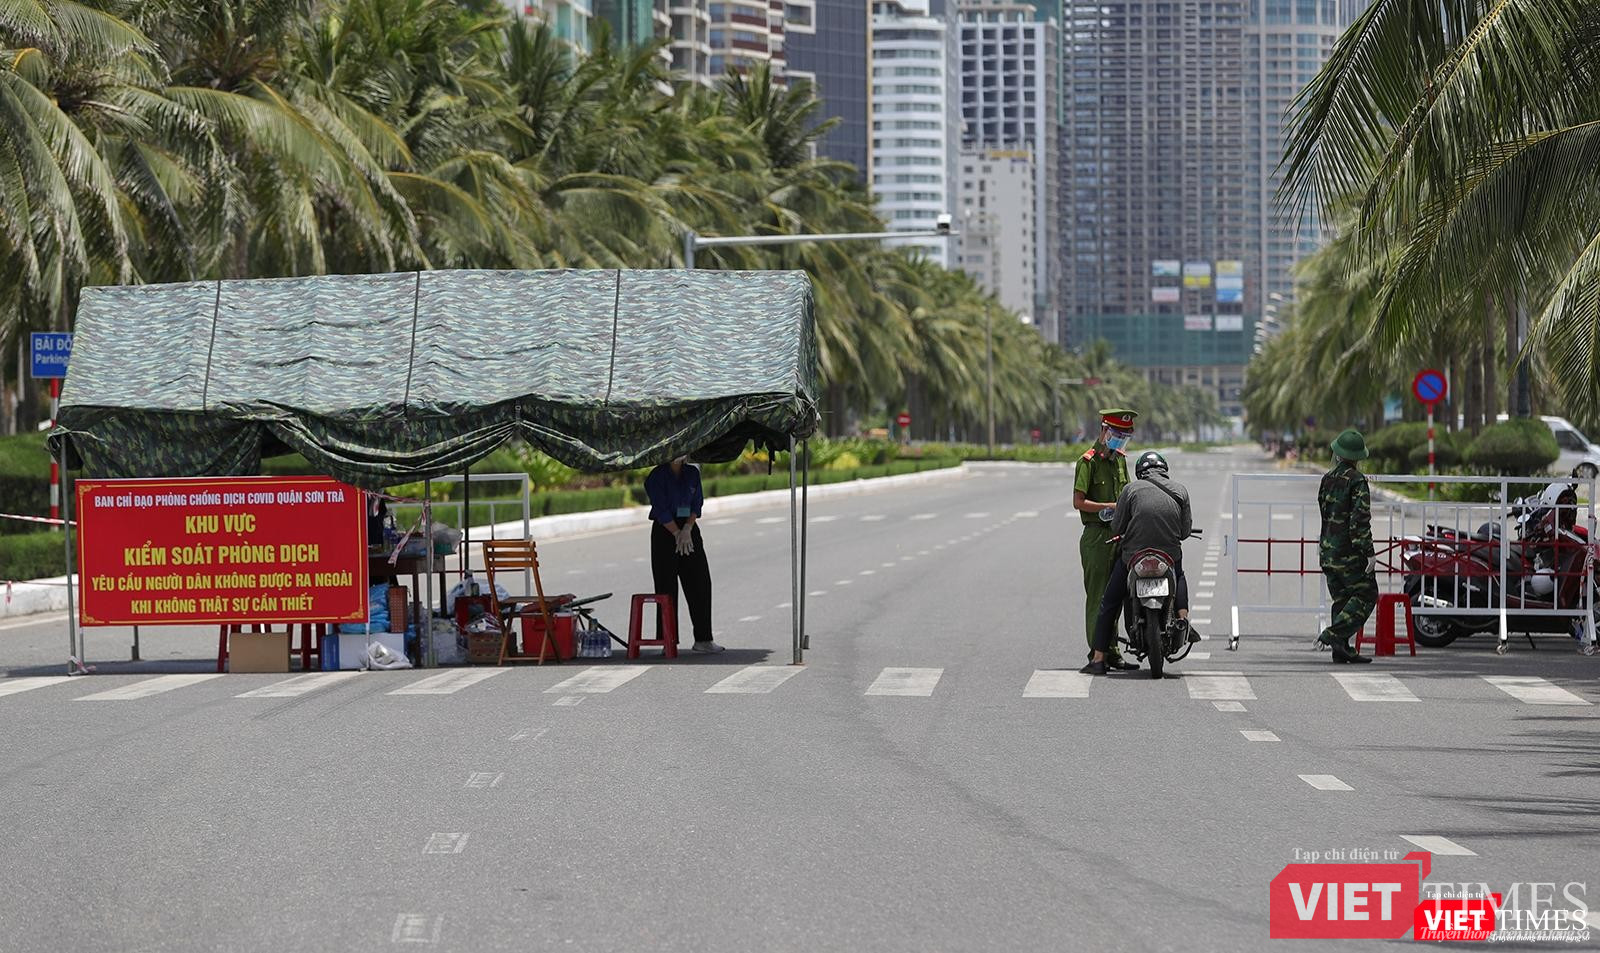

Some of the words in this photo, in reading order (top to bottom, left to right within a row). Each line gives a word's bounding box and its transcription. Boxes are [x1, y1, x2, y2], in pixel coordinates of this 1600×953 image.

[94, 496, 114, 507] BAN
[116, 492, 132, 507] CHỈ
[134, 495, 153, 509] ĐẠO
[155, 492, 187, 506] PHÒNG
[189, 489, 221, 505] CHỐNG
[223, 493, 245, 507] DỊCH
[248, 493, 275, 504] COVID
[277, 490, 302, 506] QUẬN
[305, 491, 324, 503] SƠN
[326, 489, 344, 503] TRÀ
[185, 515, 218, 534] KHU
[224, 513, 256, 537] VỰC
[124, 540, 166, 566] KIỂM
[171, 545, 213, 565] SOÁT
[218, 541, 275, 563] PHÒNG
[280, 544, 319, 565] DỊCH
[92, 574, 115, 591] YÊU
[118, 574, 142, 591] CẦU
[145, 574, 183, 590] NGƯỜI
[186, 573, 211, 589] DÂN
[214, 573, 256, 588] KHÔNG
[259, 573, 292, 590] ĐƯỢC
[295, 573, 312, 587] RA
[315, 570, 352, 587] NGOÀI
[131, 600, 151, 614] KHI
[155, 598, 196, 613] KHÔNG
[200, 597, 229, 616] THẬT
[232, 597, 251, 615] SỰ
[253, 593, 277, 612] CẦN
[280, 592, 314, 611] THIẾT
